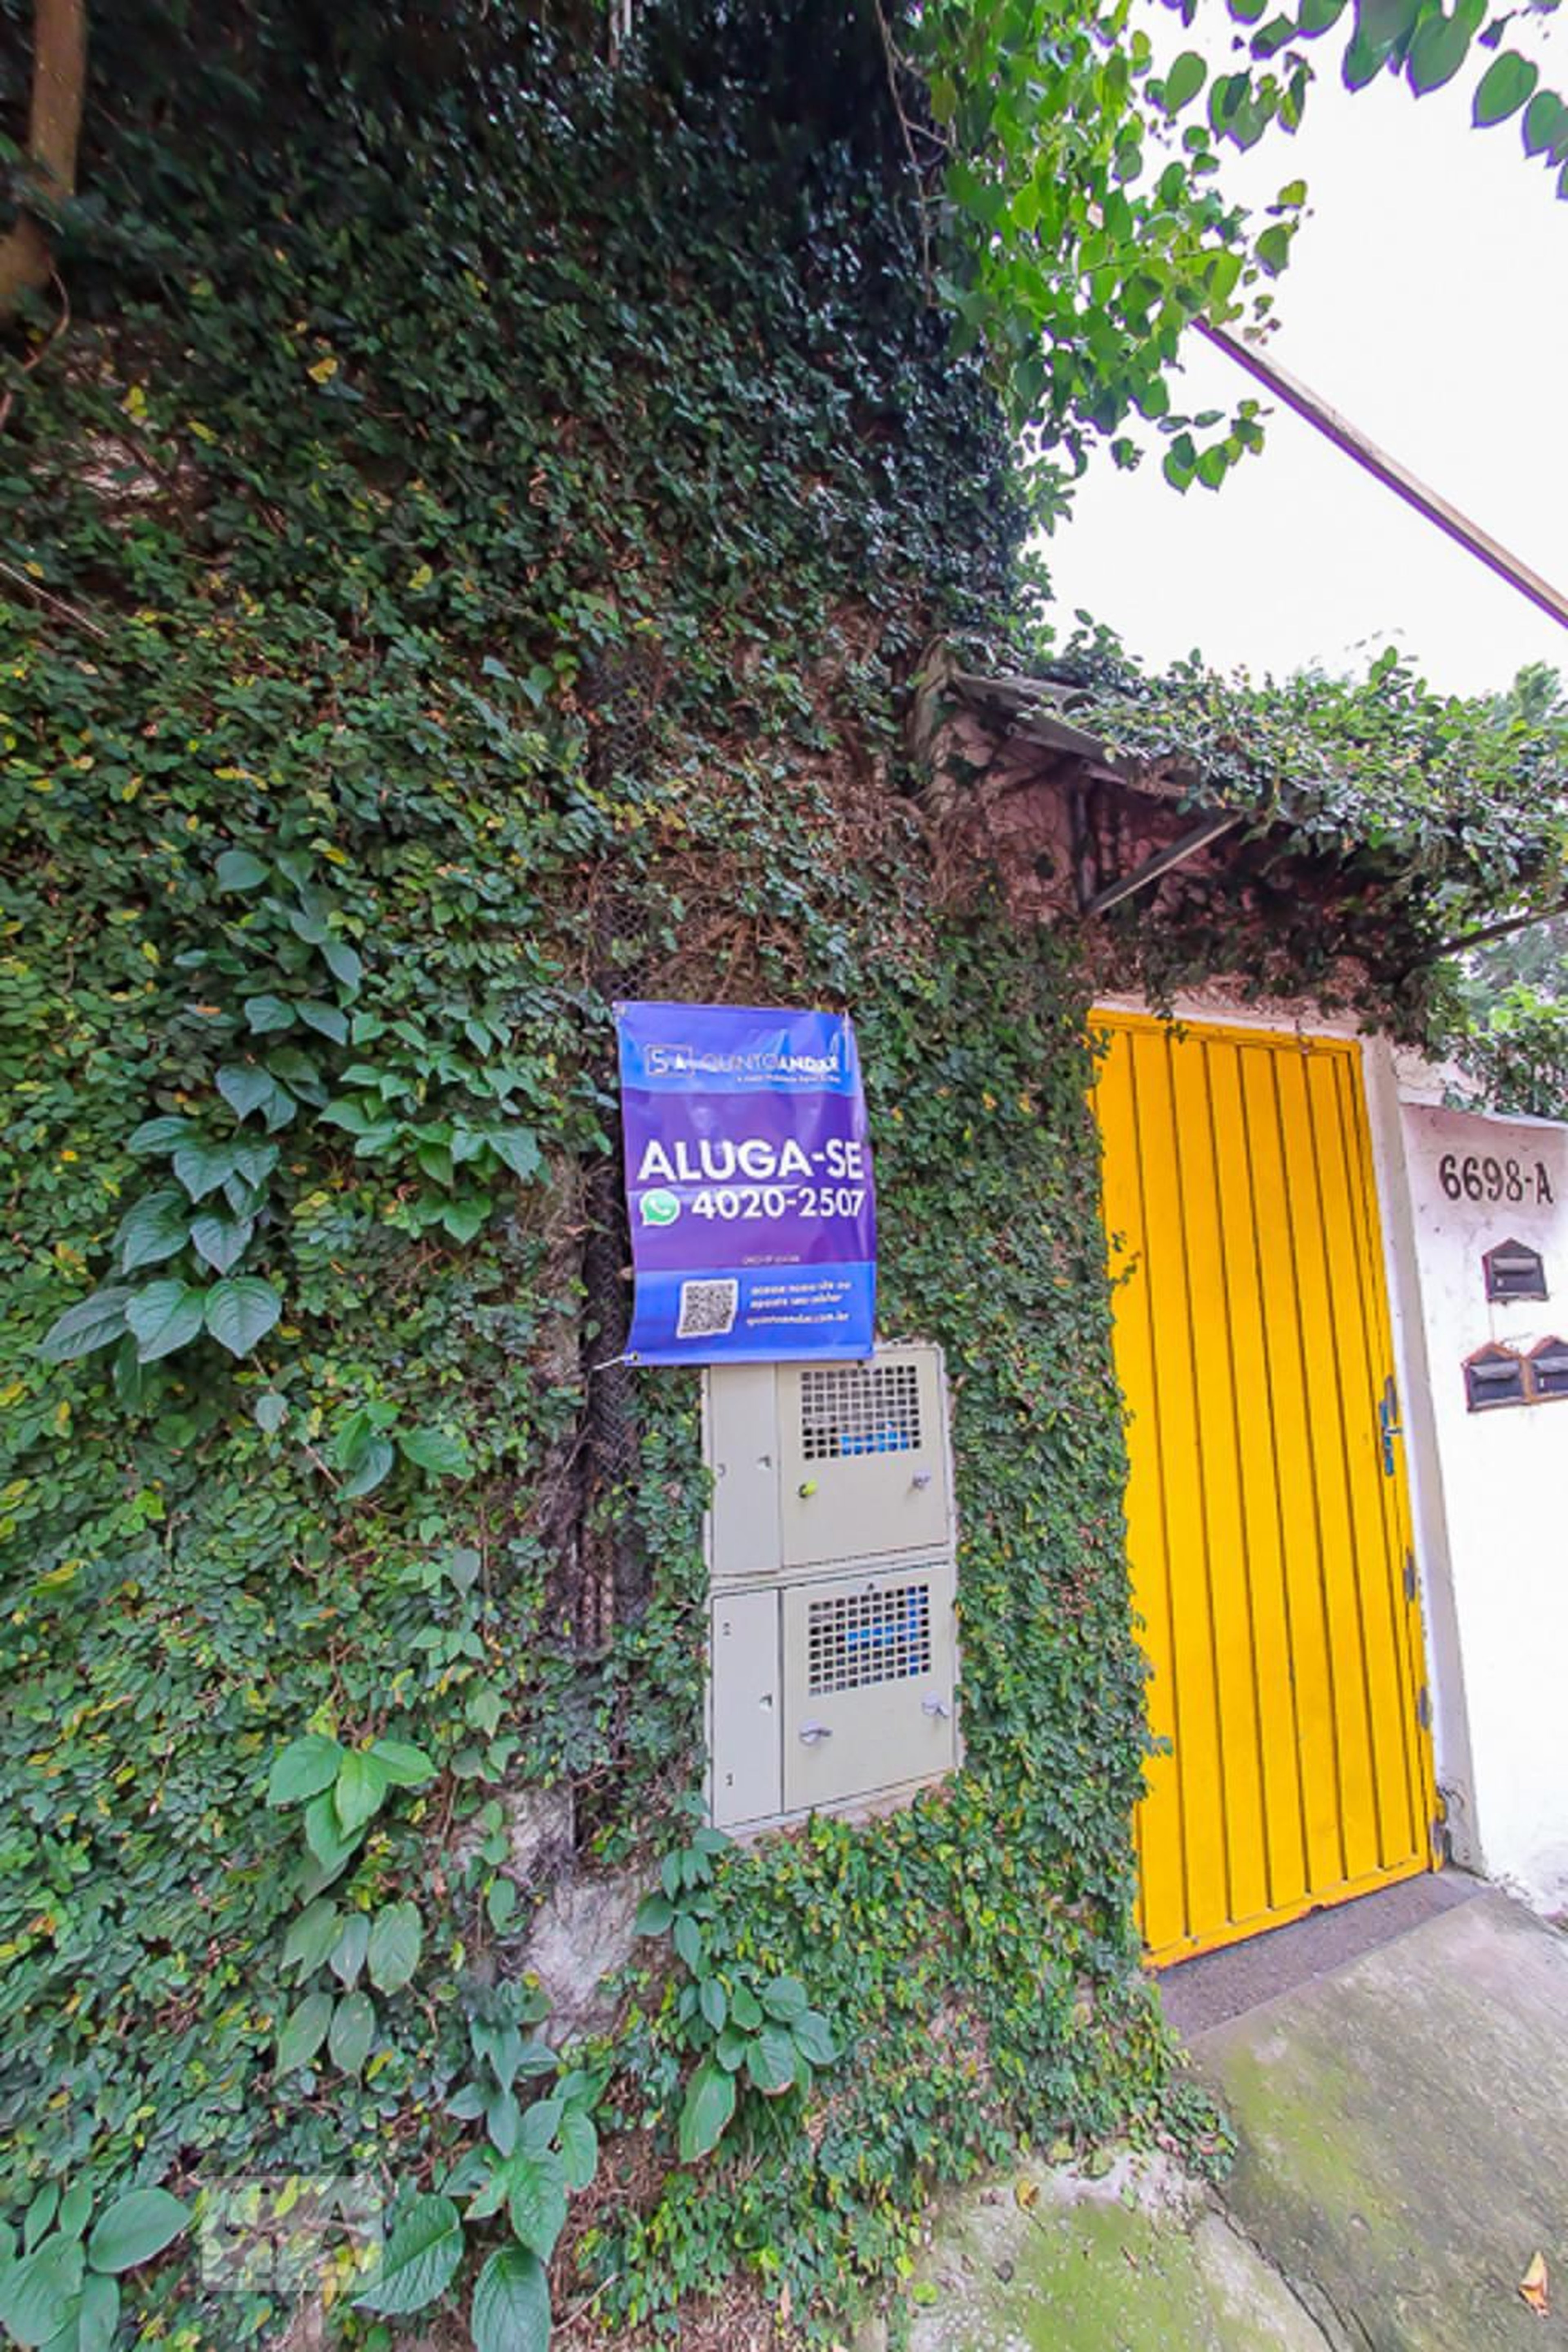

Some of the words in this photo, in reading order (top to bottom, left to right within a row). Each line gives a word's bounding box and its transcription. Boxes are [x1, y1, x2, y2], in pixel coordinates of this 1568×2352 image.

[637, 1138, 864, 1182] ALUGA-SE
[1439, 1154, 1553, 1204] 6698-A
[692, 1188, 865, 1219] 4020-2507
